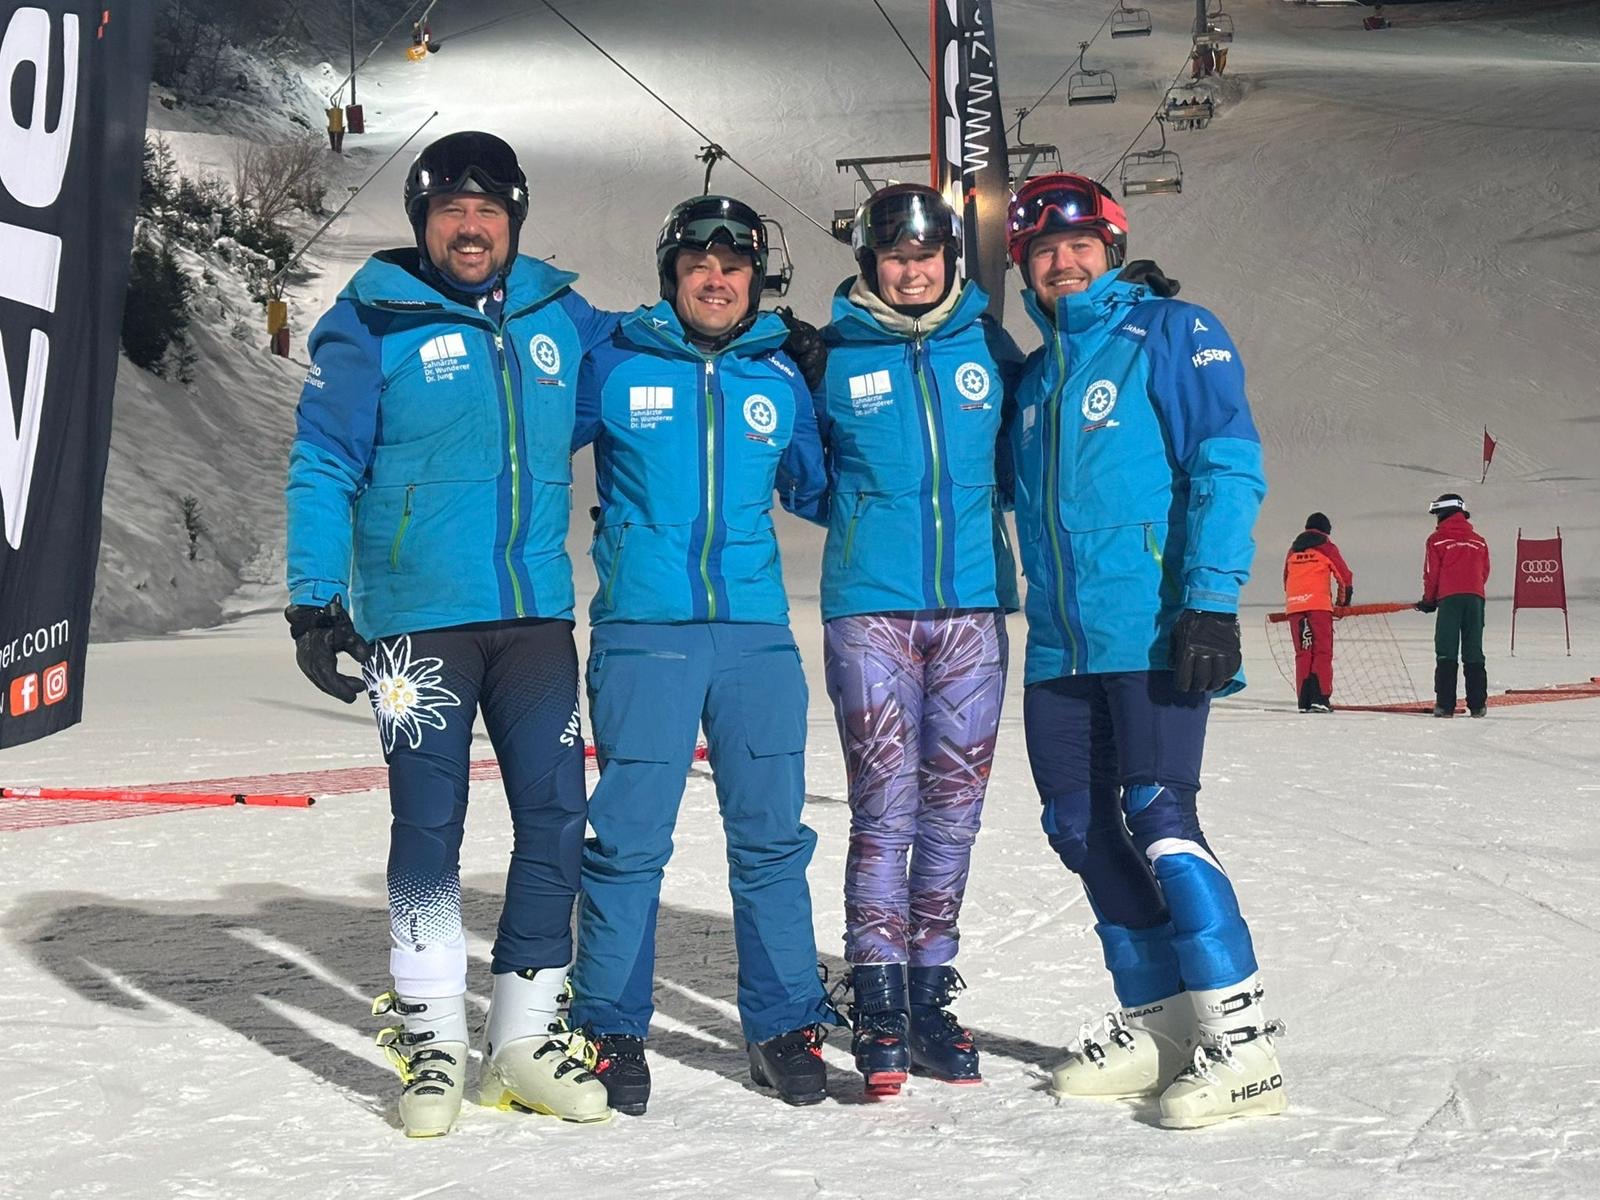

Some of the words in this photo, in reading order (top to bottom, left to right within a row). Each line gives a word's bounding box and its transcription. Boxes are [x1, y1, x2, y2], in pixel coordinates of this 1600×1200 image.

[423, 359, 458, 369] Zahnärzte
[435, 364, 470, 374] Wunderer
[1526, 575, 1553, 583] Audi
[559, 701, 580, 748] SWI
[1125, 1005, 1163, 1020] HEAD
[1231, 1073, 1283, 1103] HEAD
